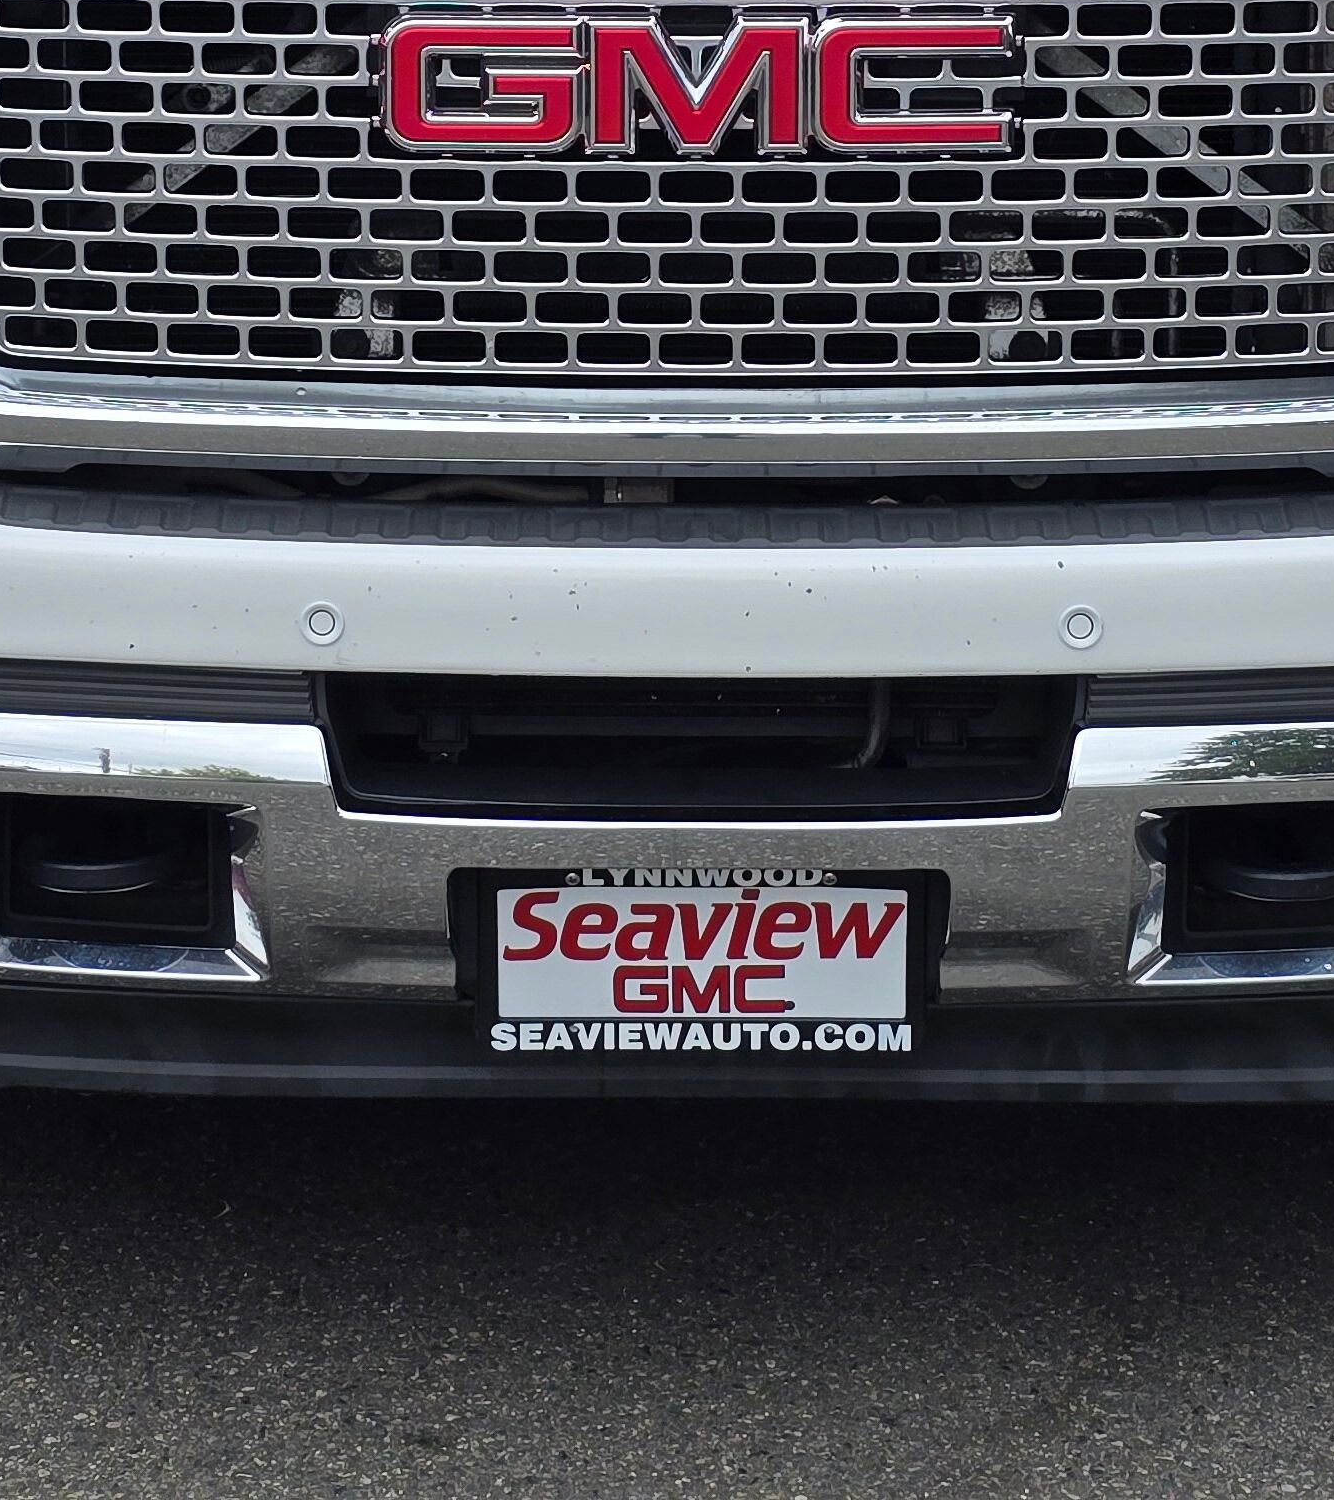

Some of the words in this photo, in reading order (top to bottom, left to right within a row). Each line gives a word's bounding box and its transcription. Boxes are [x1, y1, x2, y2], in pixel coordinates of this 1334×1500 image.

[385, 14, 1014, 155] GMC
[582, 868, 824, 887] LYNNWOOD
[503, 888, 906, 961] Seaview
[612, 965, 788, 1014] GMC
[490, 1022, 913, 1053] SEAVIEWAUTO.COM
